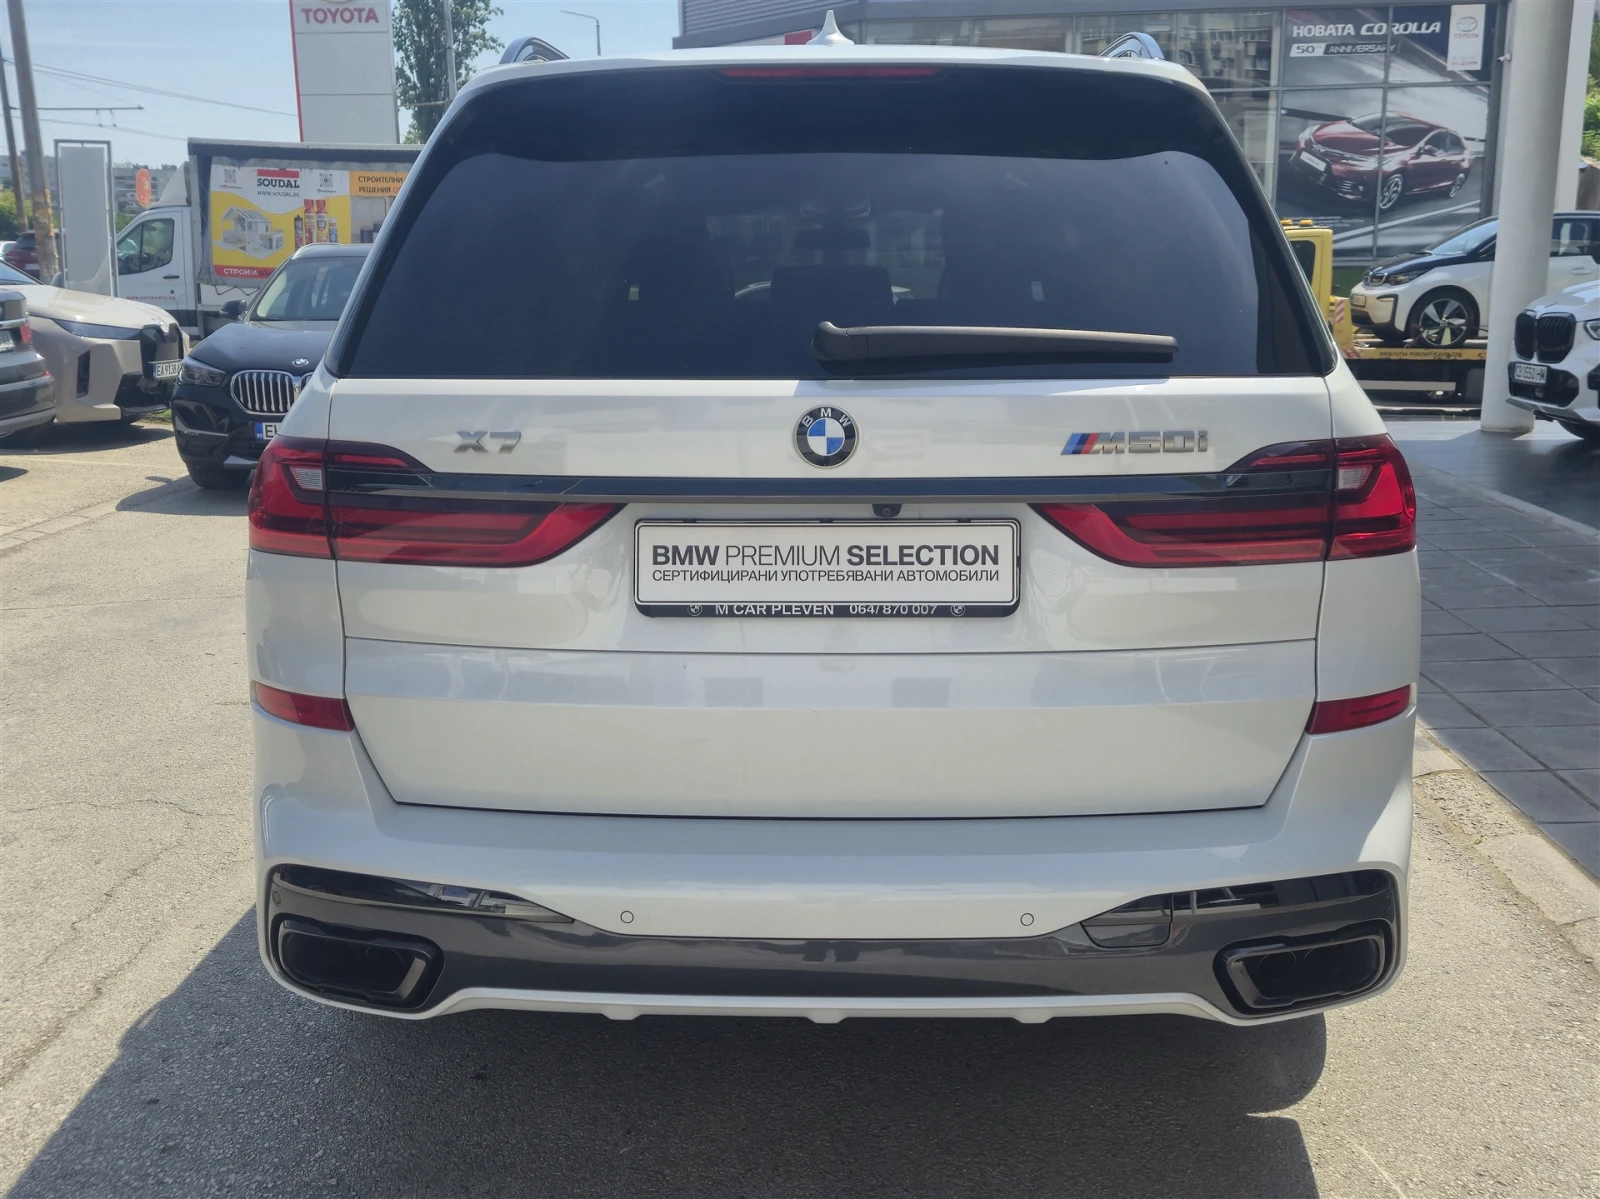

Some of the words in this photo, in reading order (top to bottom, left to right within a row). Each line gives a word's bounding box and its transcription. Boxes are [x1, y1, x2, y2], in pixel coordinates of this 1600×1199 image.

[301, 7, 380, 24] TOYOTA
[1360, 21, 1441, 36] COROLLA
[257, 178, 300, 189] SOUDAL
[801, 407, 852, 427] BMW
[453, 431, 521, 454] X7
[1088, 430, 1208, 455] M50i
[652, 544, 721, 566] BMW
[724, 544, 840, 566] PREMIUM
[846, 544, 999, 566] SELECTION
[652, 569, 778, 584] СЕРТИФИЦИРАНИ
[780, 569, 894, 582] УПОТРЕБЯВАНИ
[896, 569, 999, 582] АВТОМОБИЛИ
[715, 604, 729, 615] M
[732, 604, 768, 615] CAR
[770, 604, 835, 615] PLEVEN
